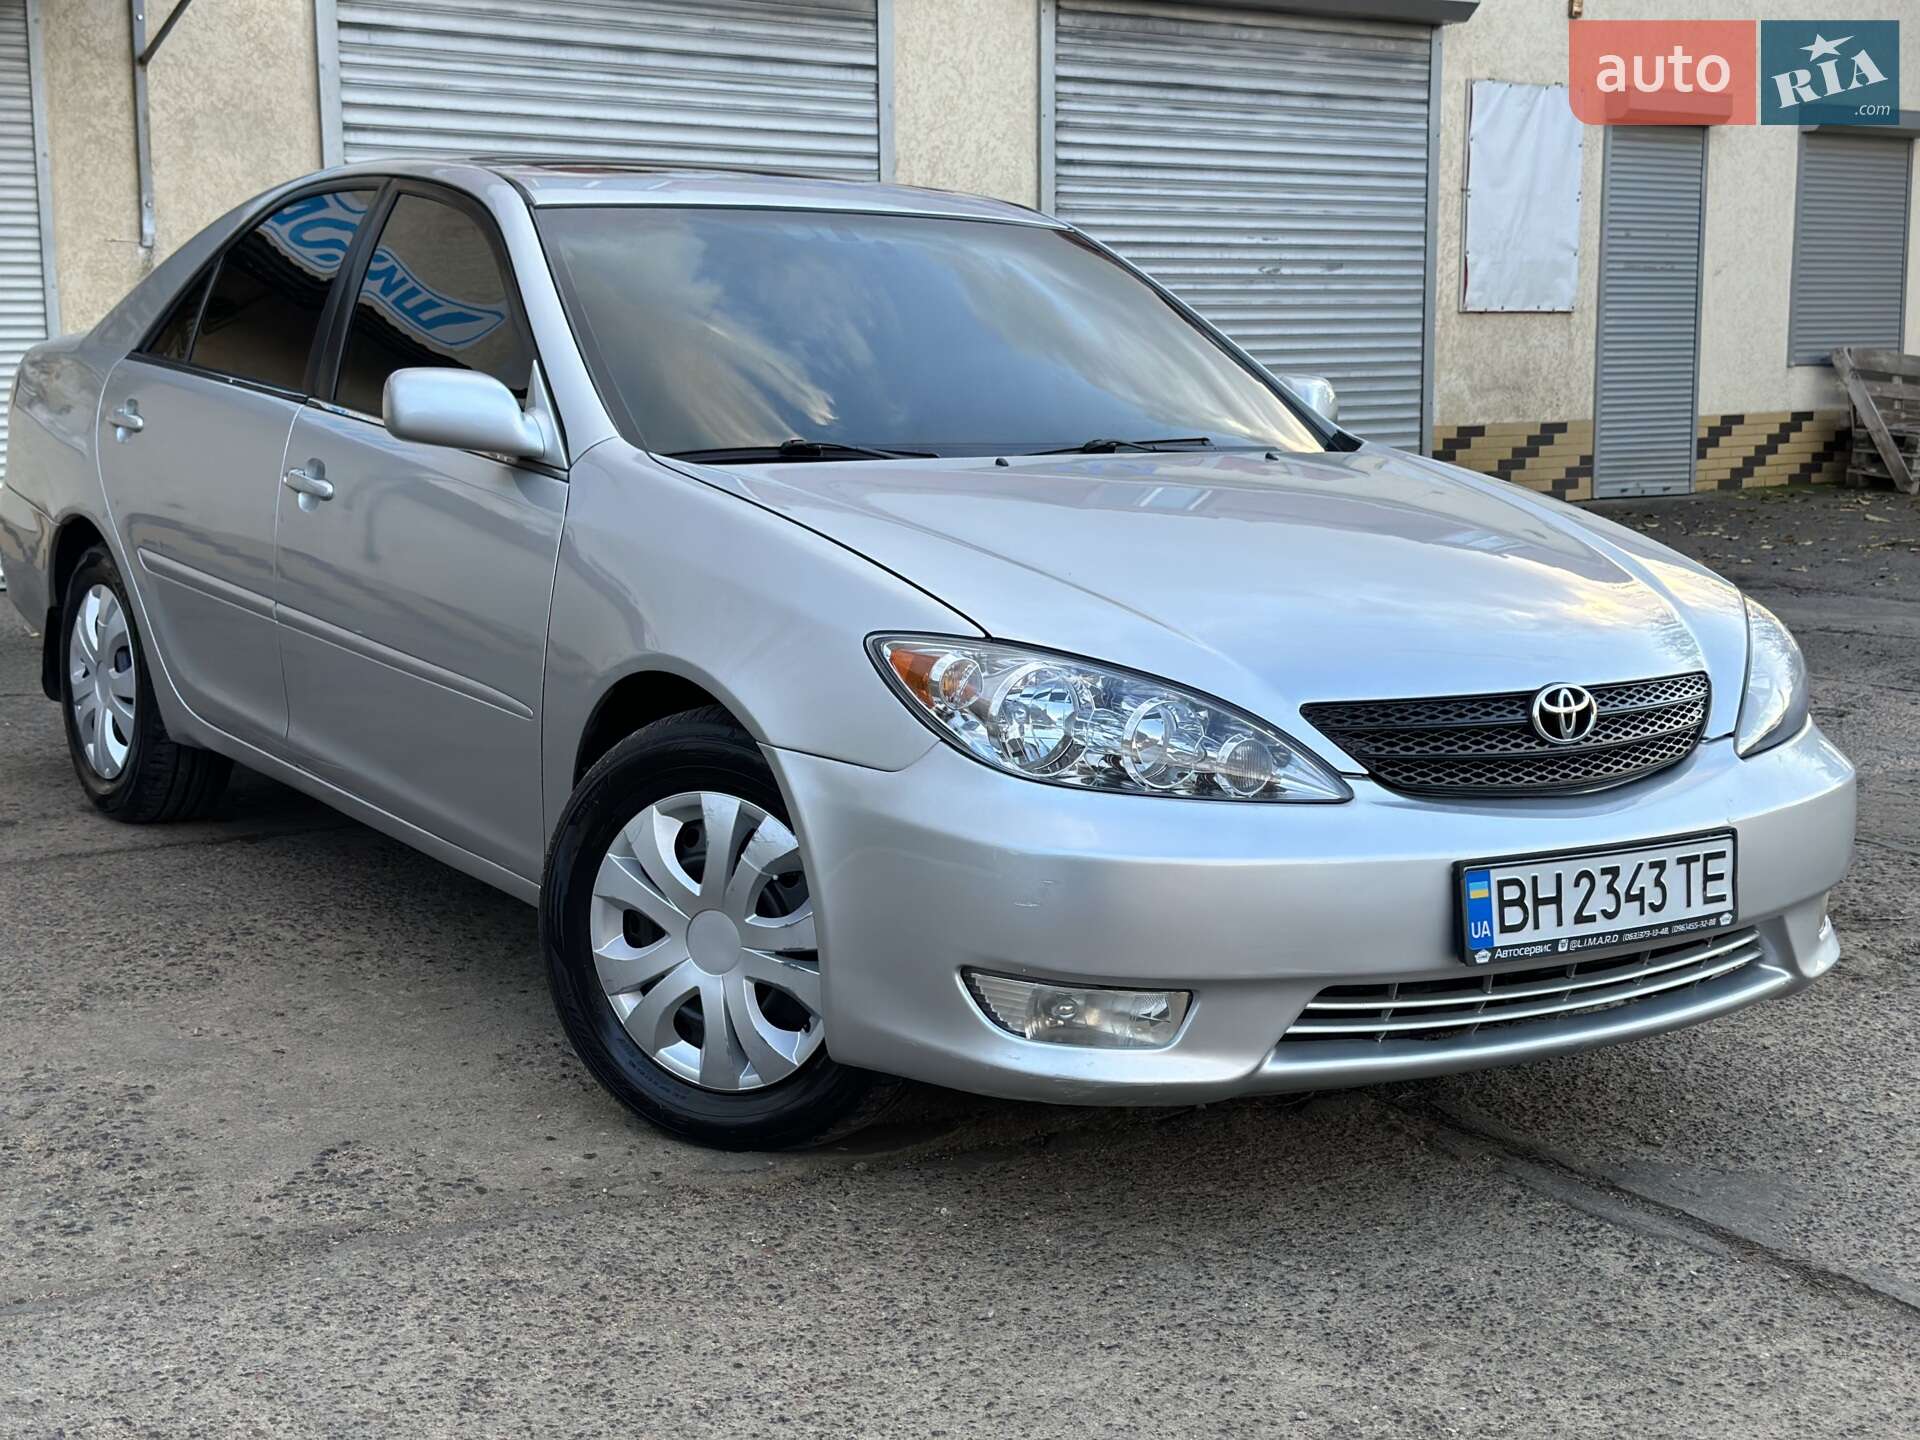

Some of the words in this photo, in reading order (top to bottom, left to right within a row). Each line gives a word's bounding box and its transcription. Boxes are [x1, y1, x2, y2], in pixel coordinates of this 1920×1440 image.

[1497, 872, 1563, 934] BH
[1573, 859, 1668, 925] 2343
[1676, 850, 1727, 907] TE
[1471, 920, 1491, 939] UA
[1494, 943, 1551, 959] Автосервис
